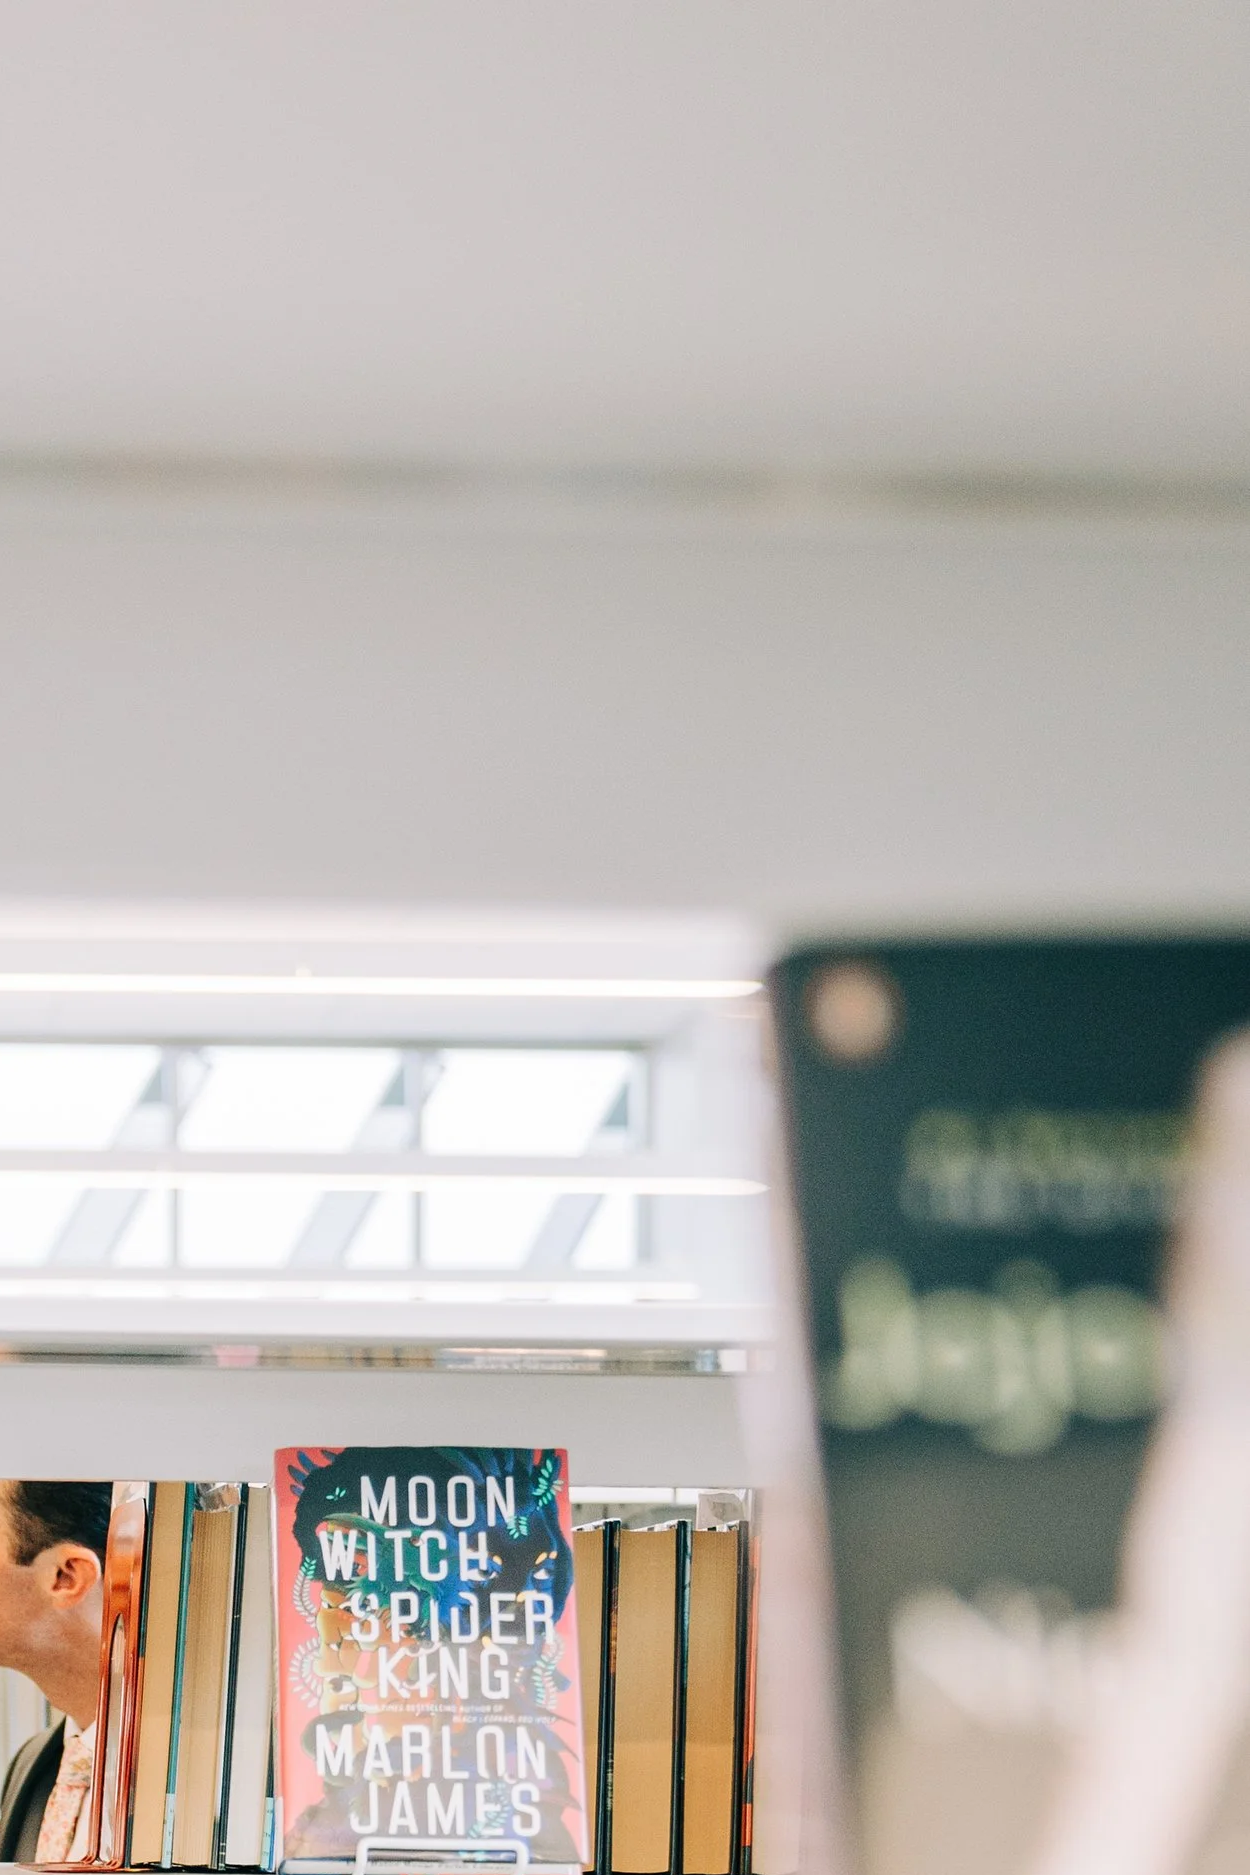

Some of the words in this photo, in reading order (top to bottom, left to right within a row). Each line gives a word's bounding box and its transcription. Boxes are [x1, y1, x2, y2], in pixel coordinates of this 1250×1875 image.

[359, 1474, 515, 1528] MOON
[319, 1530, 489, 1582] WITCH
[350, 1591, 555, 1645] SPIDER
[378, 1646, 509, 1700] KING
[315, 1723, 547, 1780] MARLON
[349, 1783, 542, 1838] JAMES
